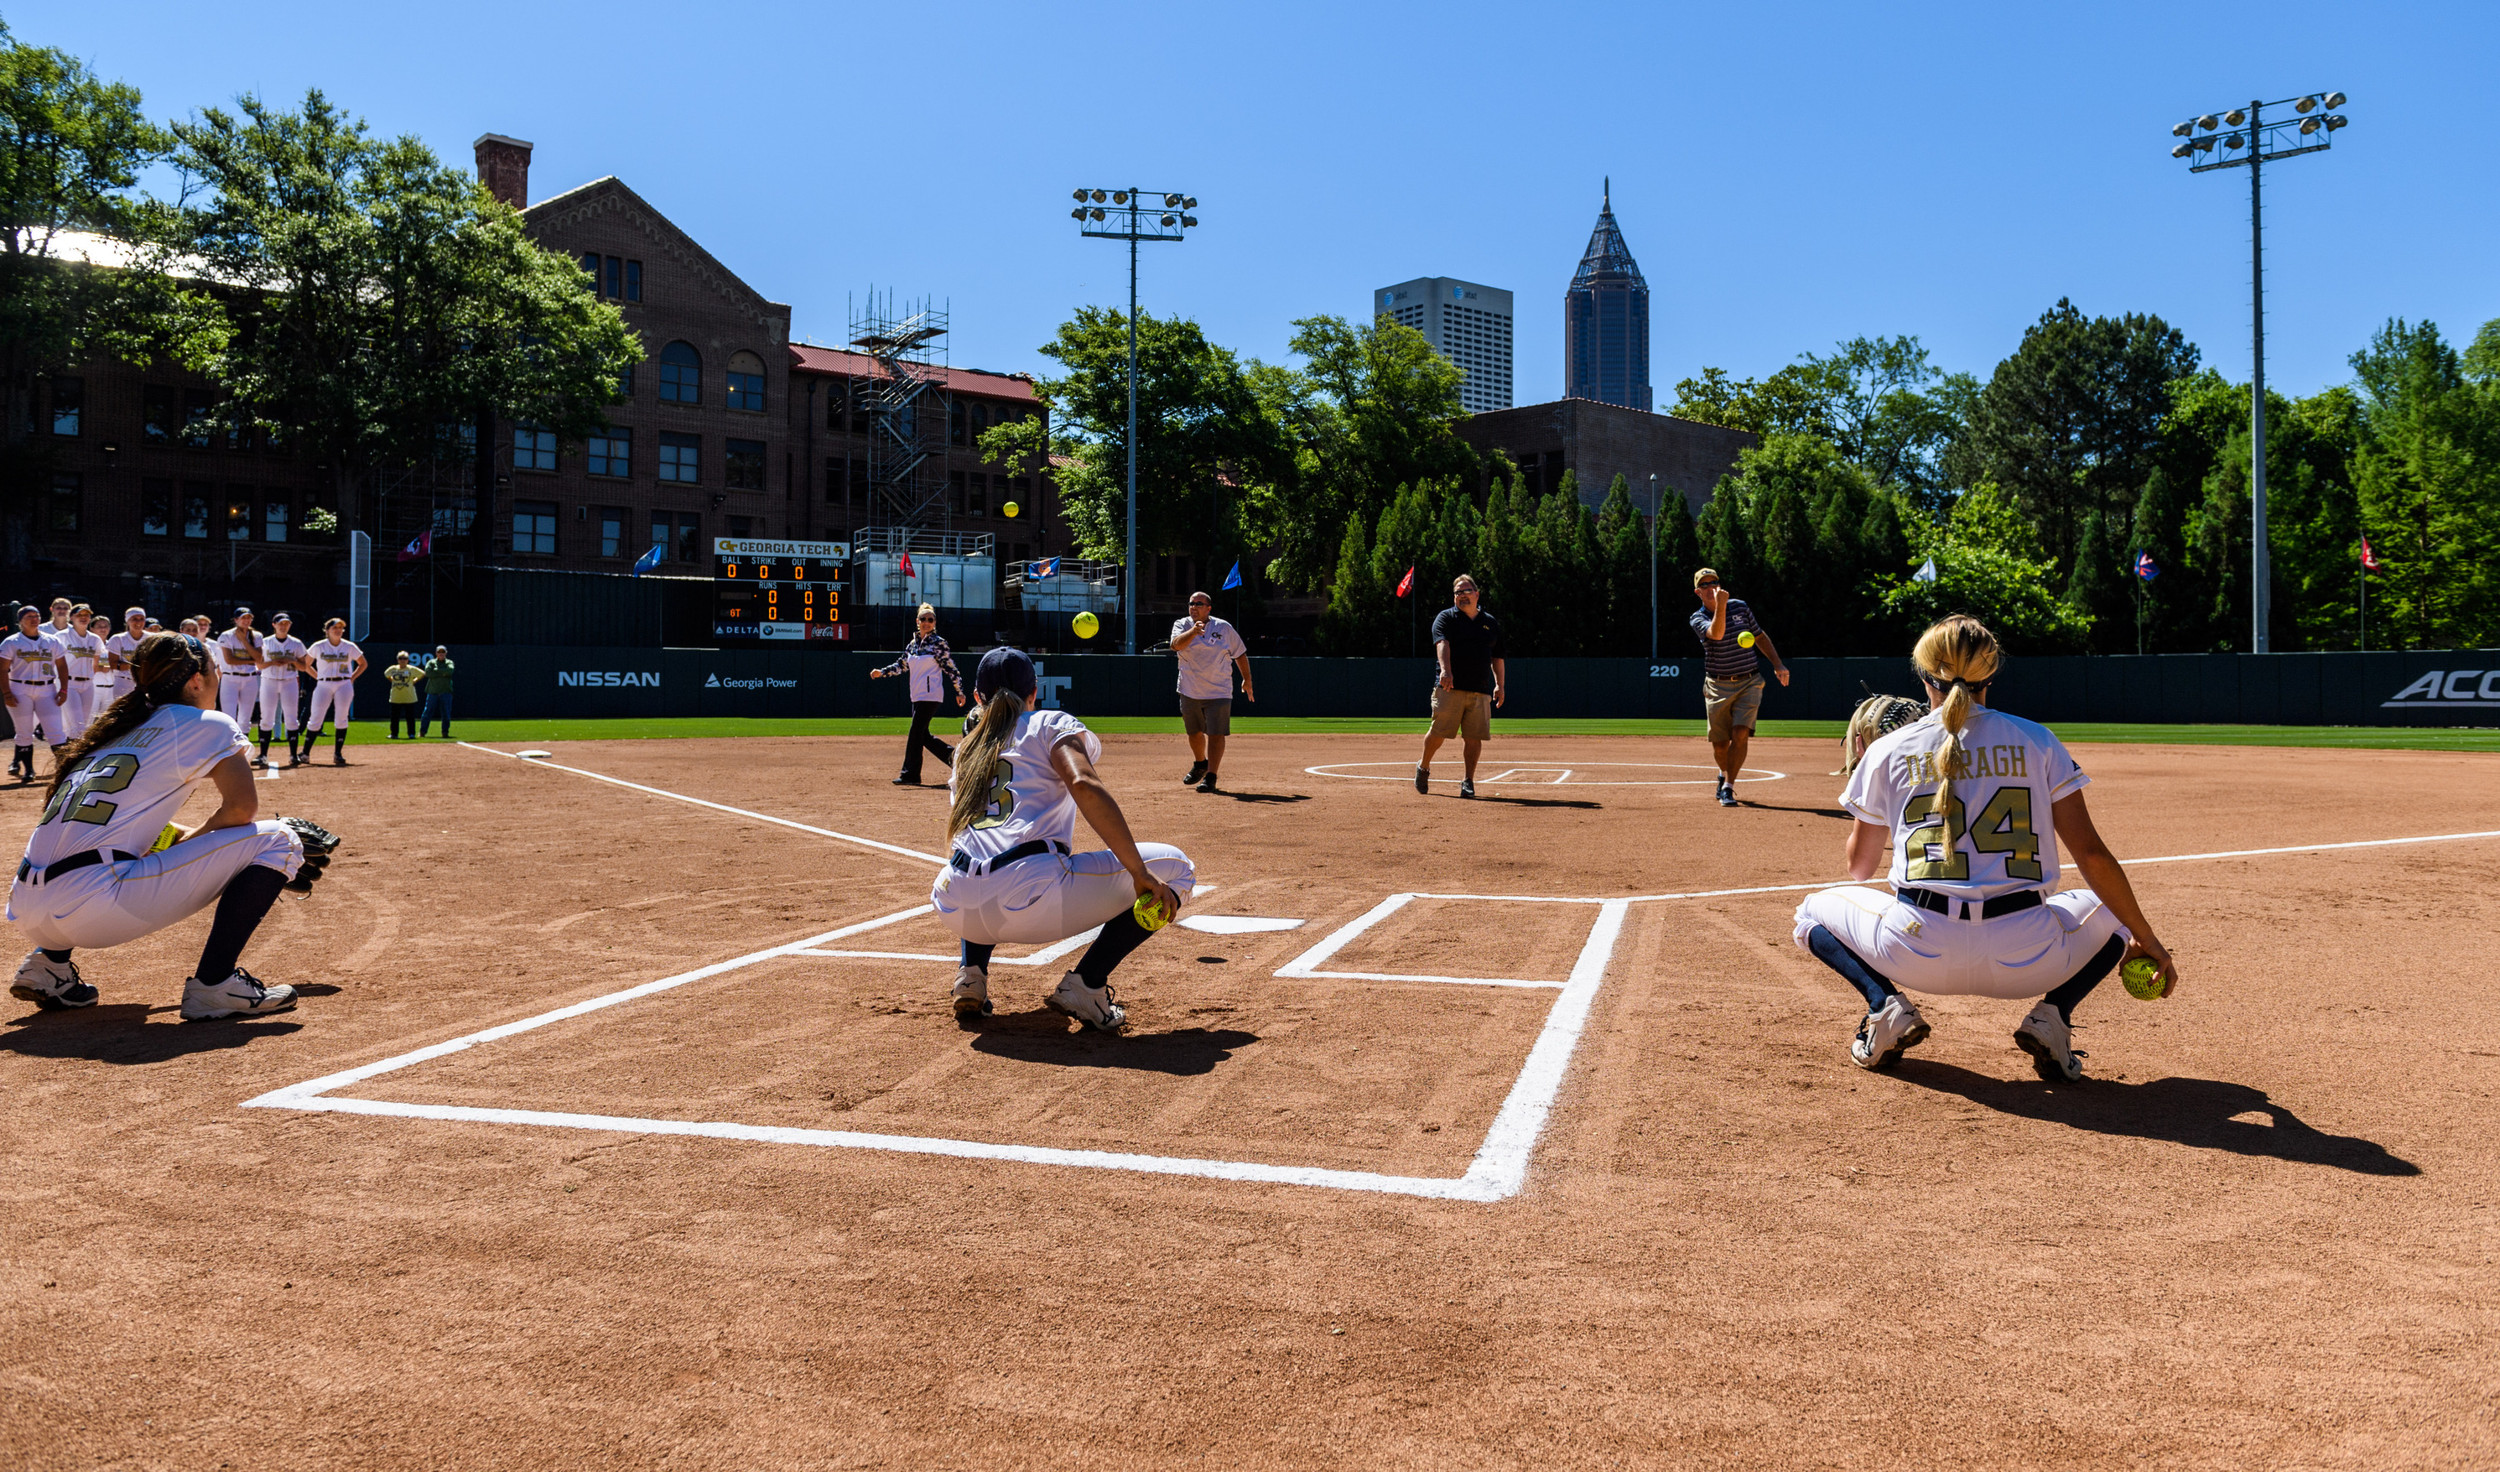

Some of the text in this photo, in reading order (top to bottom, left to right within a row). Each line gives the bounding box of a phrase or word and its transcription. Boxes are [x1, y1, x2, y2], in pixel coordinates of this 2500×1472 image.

[740, 542, 796, 554] GEORGIA
[798, 544, 831, 555] TECH
[722, 555, 843, 567] BALL STRIKE OUT INNING
[727, 563, 737, 578] 0
[759, 565, 768, 579] 0
[795, 566, 804, 580] 0
[834, 568, 838, 580] 1
[759, 581, 842, 591] RUNS HITS ERR
[768, 590, 777, 604] 0
[804, 591, 813, 605] 0
[830, 591, 838, 605] 0
[768, 606, 777, 620] 0
[804, 607, 813, 621] 0
[830, 608, 838, 622] 0
[726, 626, 759, 634] DELTA
[1650, 665, 1680, 677] 220
[558, 671, 661, 687] NISSAN
[723, 677, 798, 690] Georgia Power
[1905, 745, 2028, 787] DARAGH
[1904, 786, 2043, 883] 24
